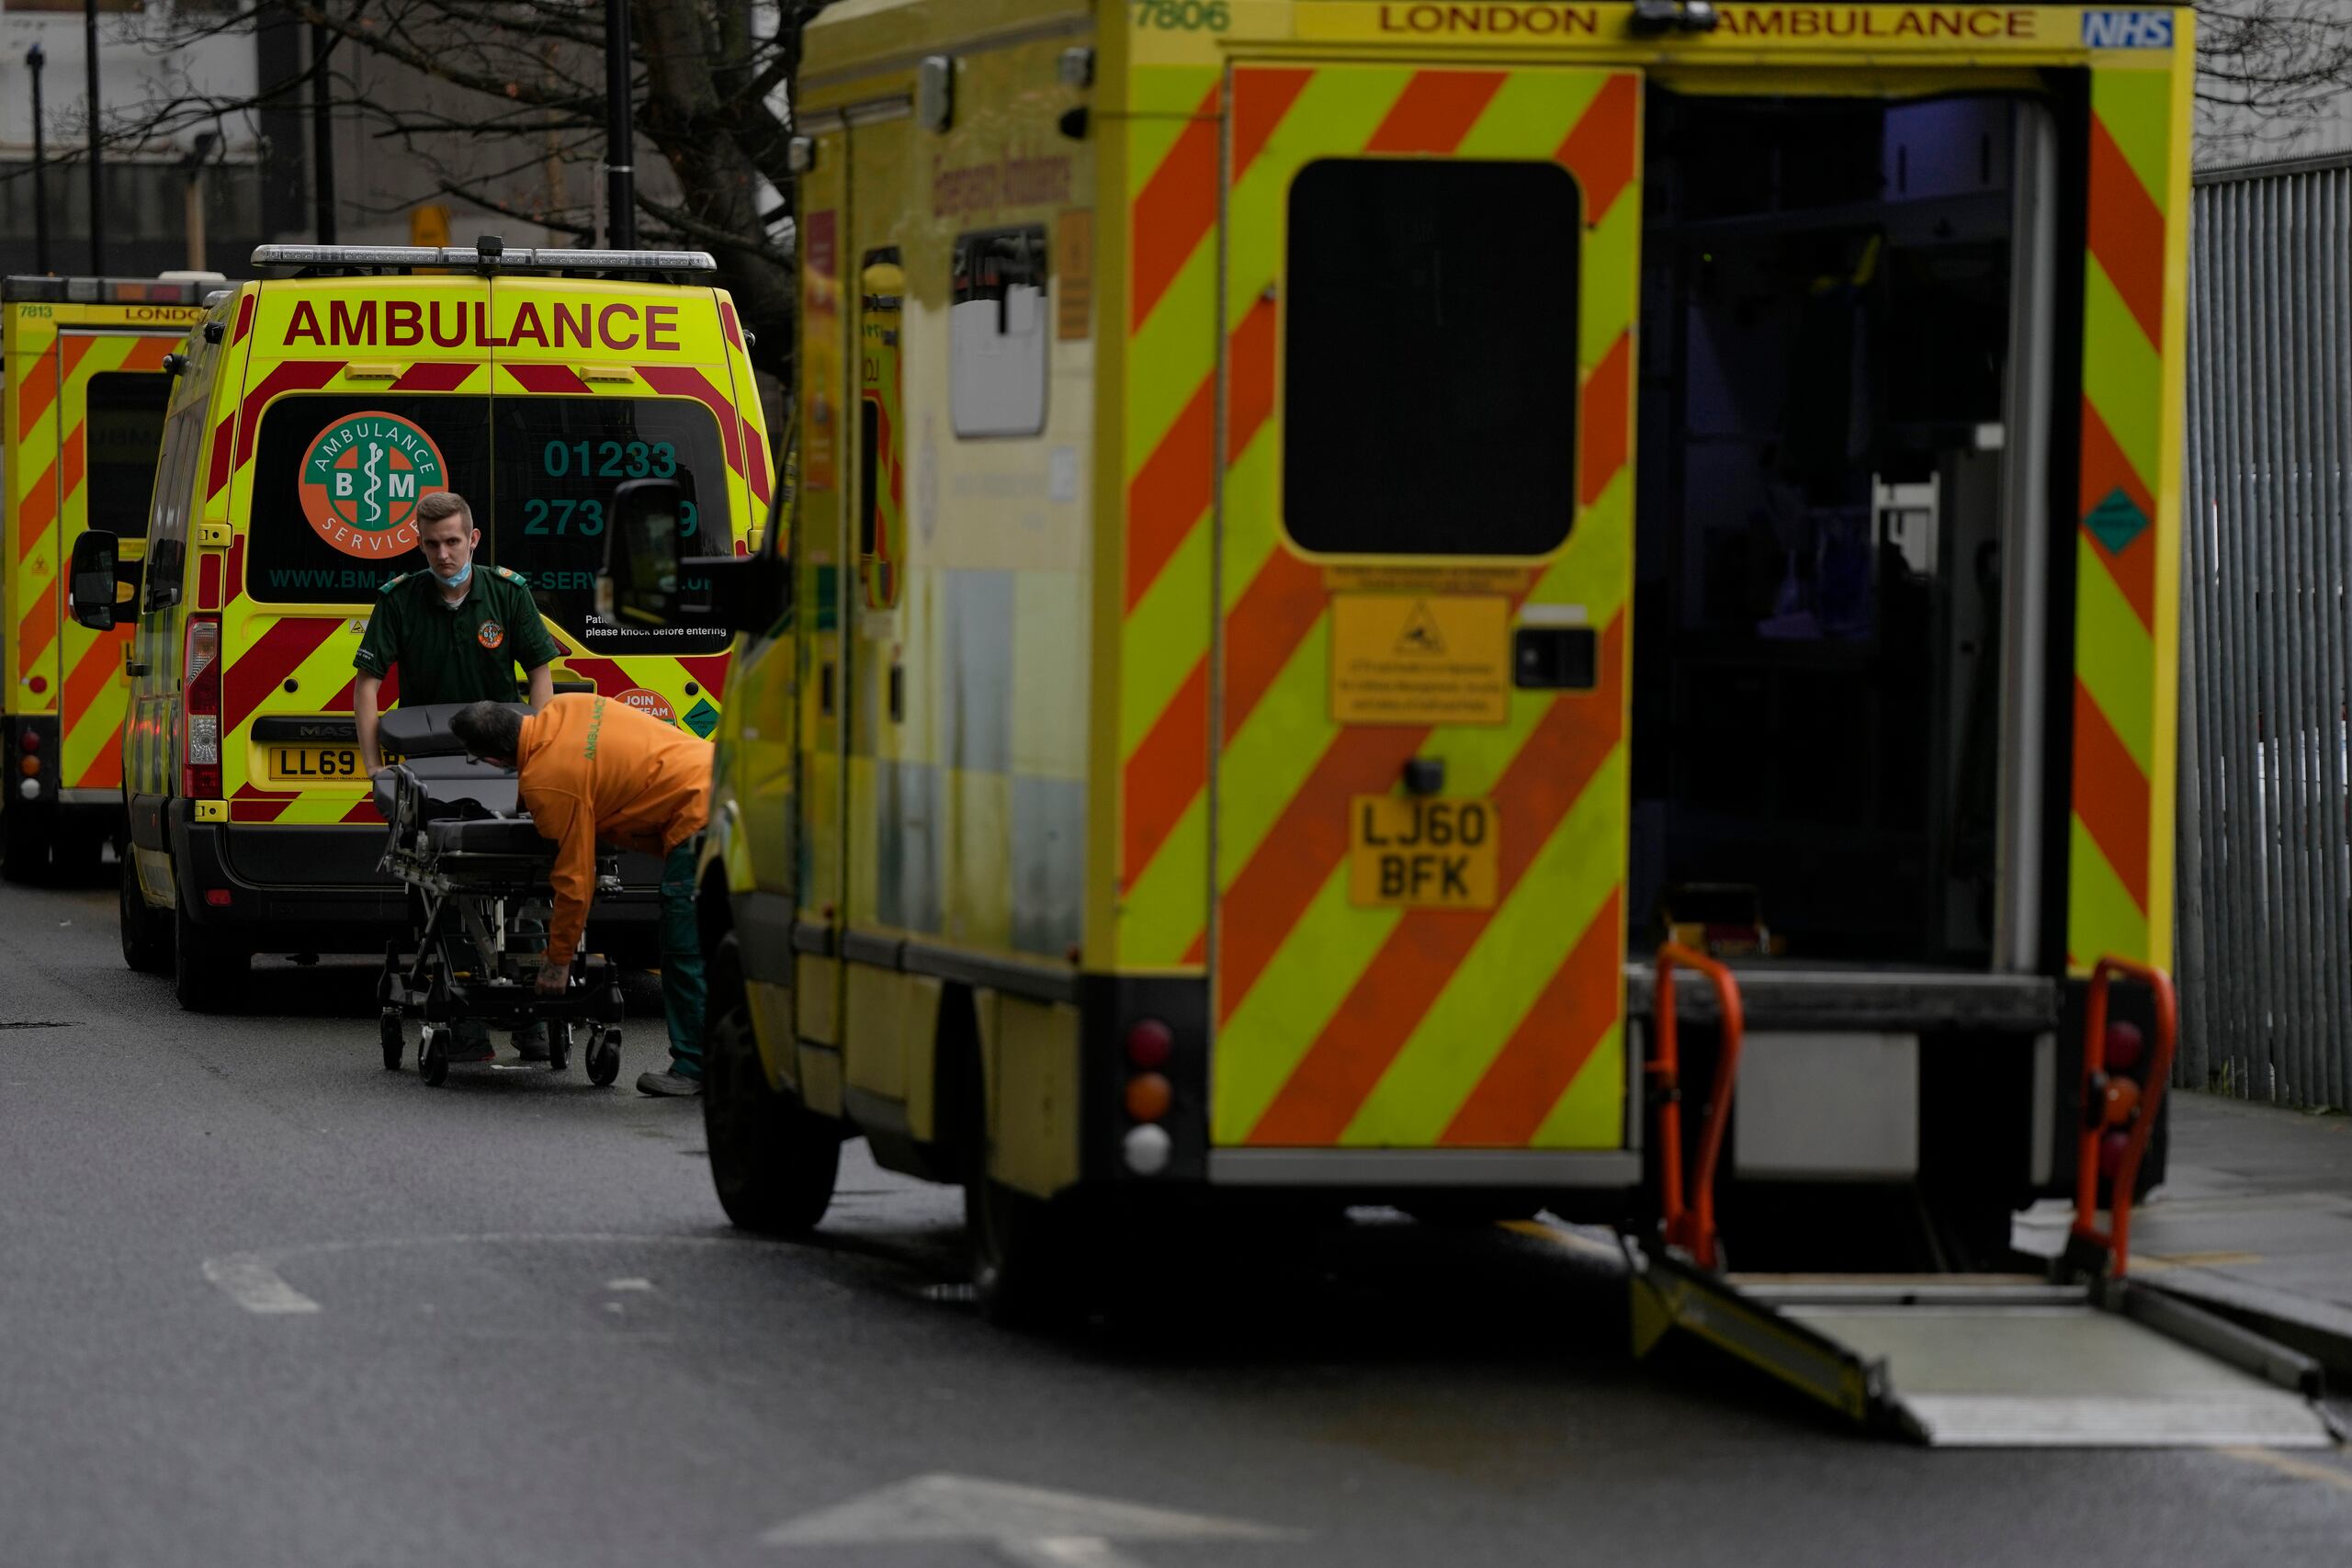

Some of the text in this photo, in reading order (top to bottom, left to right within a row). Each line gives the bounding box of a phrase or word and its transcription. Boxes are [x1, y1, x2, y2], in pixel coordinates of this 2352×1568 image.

[1136, 0, 1231, 31] 7806
[1381, 5, 2036, 39] LONDON AMBULANCE
[2084, 11, 2171, 47] NHS
[20, 305, 52, 319] 7813
[125, 308, 199, 321] LONDO
[283, 299, 681, 351] AMBULANCE
[314, 423, 435, 475] AMBULANCE
[544, 440, 677, 478] 01233
[336, 472, 414, 497] B M
[585, 627, 618, 637] please
[653, 627, 684, 636] before
[686, 626, 727, 637] entering
[625, 695, 654, 706] JOIN
[281, 750, 355, 775] LL69
[1363, 803, 1487, 847] LJ60
[1381, 854, 1468, 898] BFK
